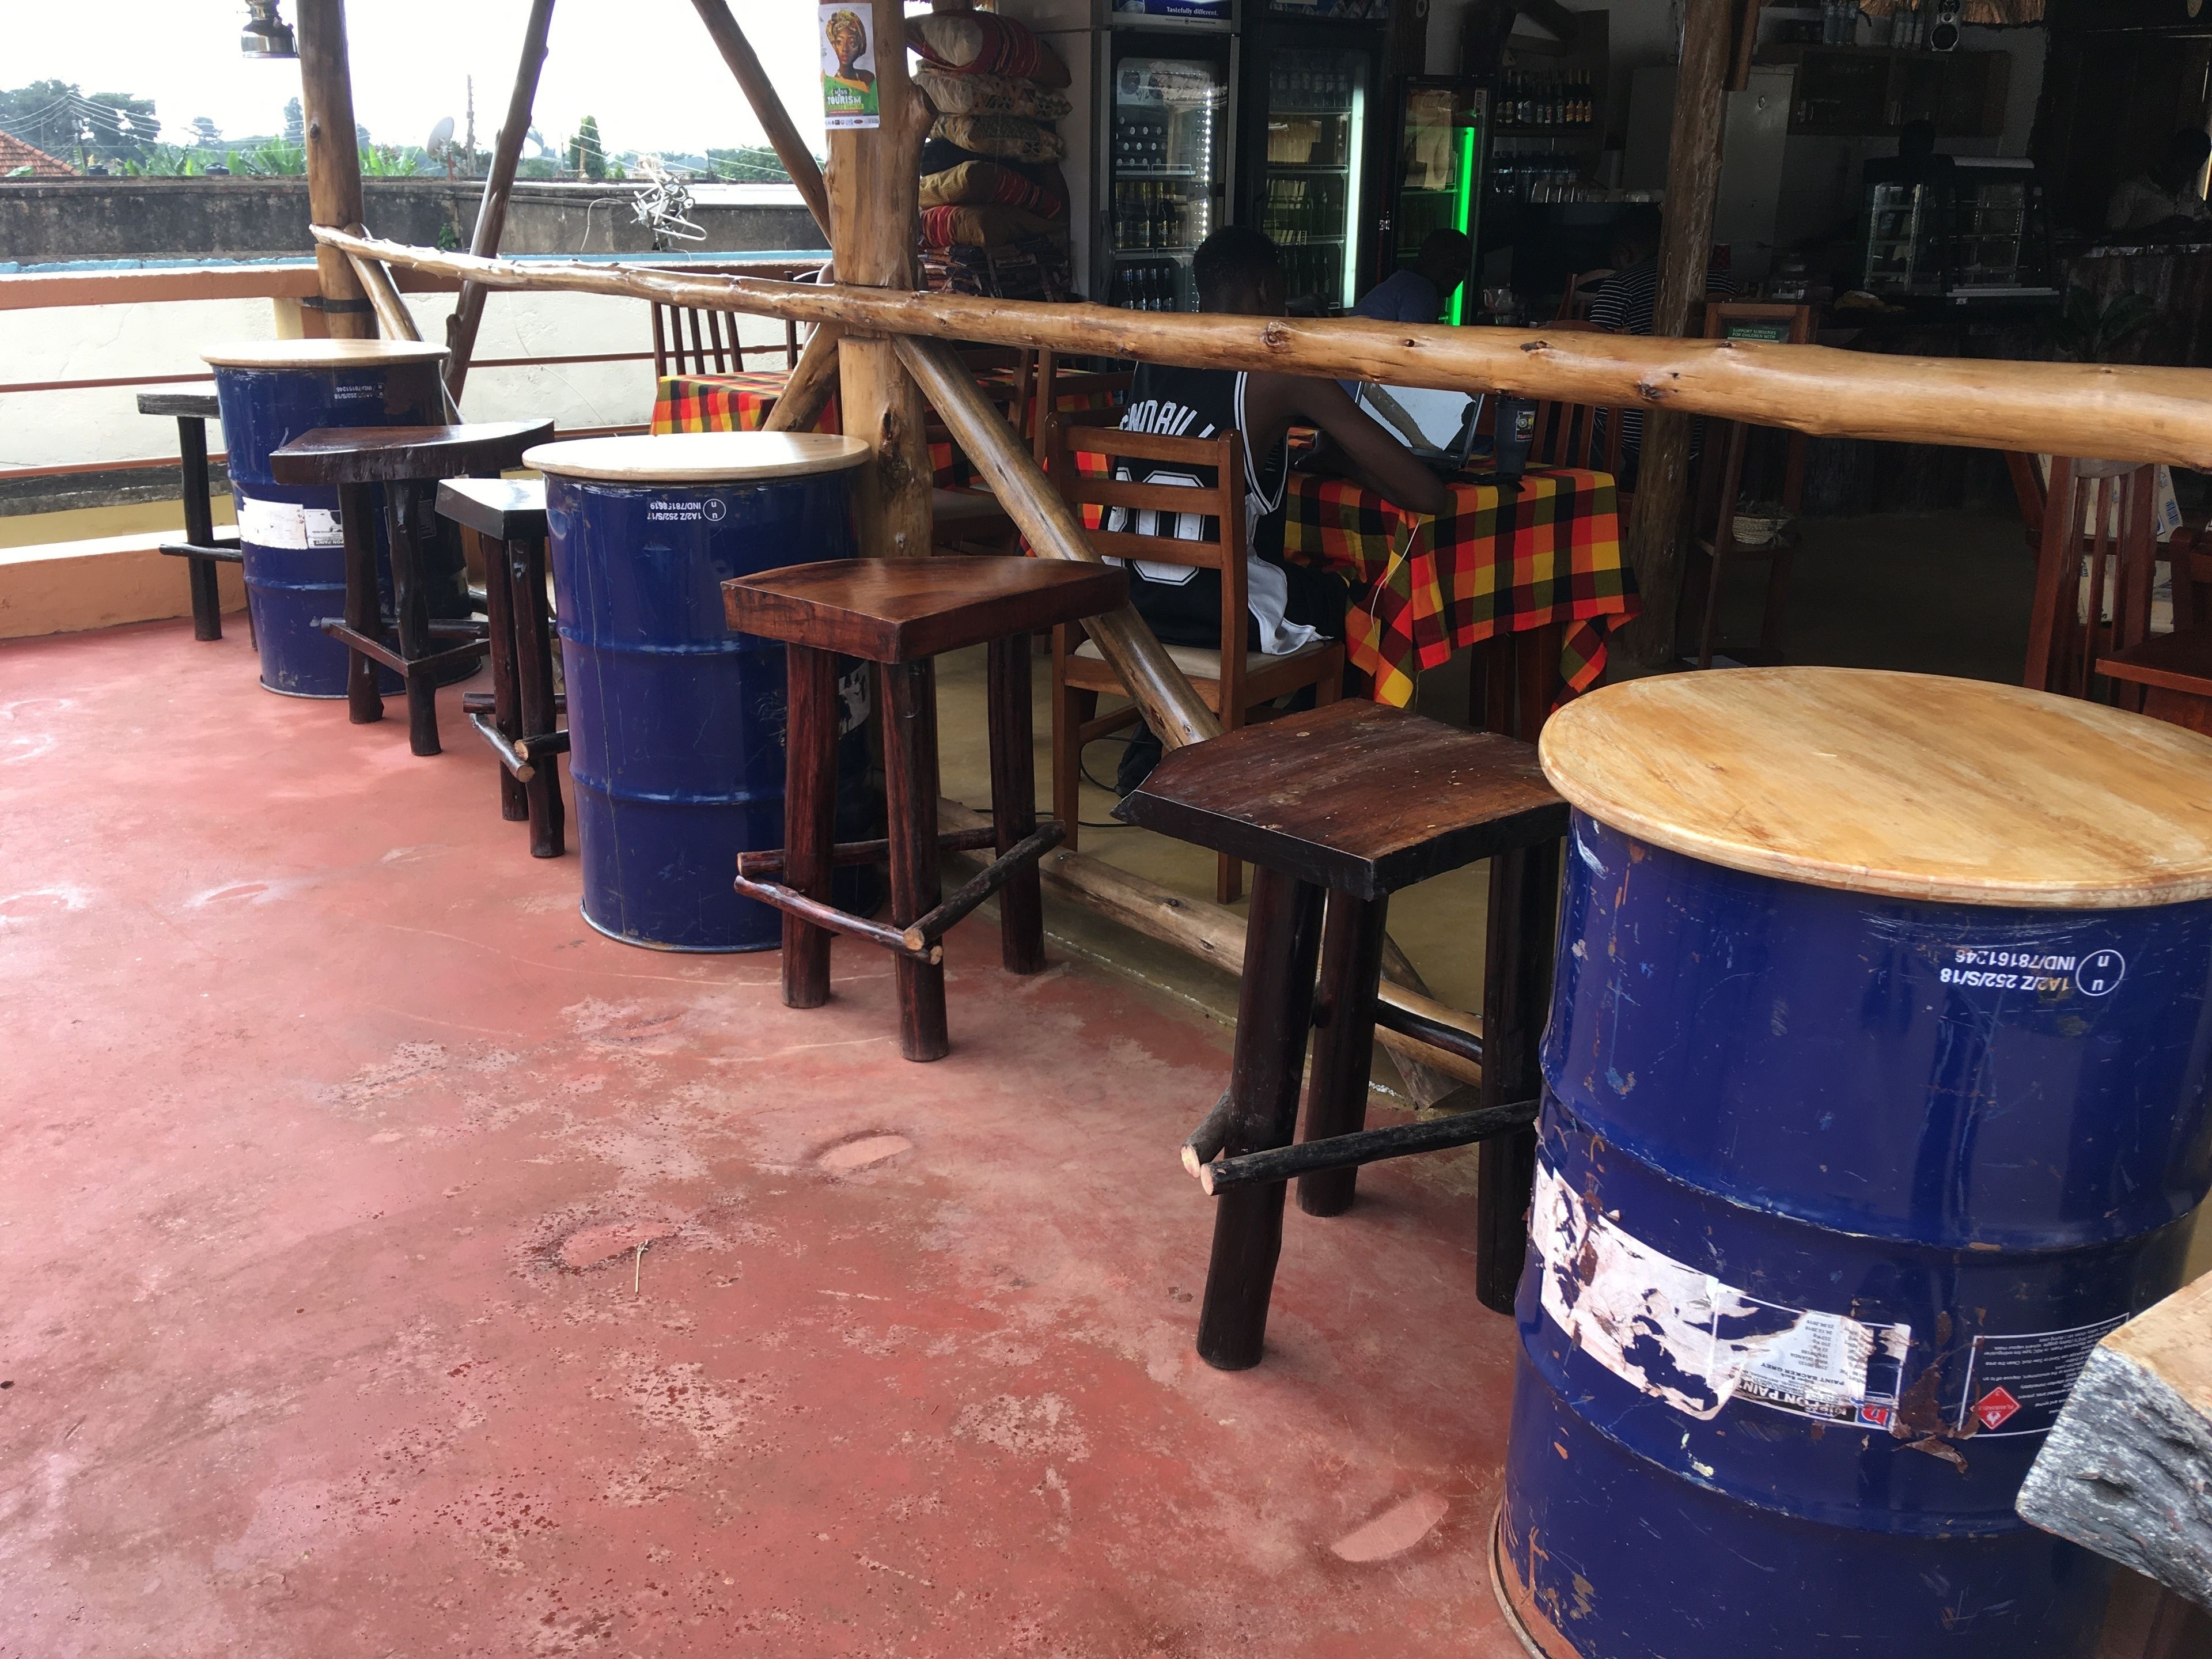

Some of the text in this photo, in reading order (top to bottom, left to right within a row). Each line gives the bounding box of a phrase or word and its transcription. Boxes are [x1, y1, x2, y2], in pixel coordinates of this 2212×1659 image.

[1166, 6, 1192, 15] Tastefully
[827, 96, 861, 104] TOURISM
[1941, 968, 2069, 991] 1A2/Z 252/S/18
[2092, 980, 2104, 991] u
[1760, 1362, 1782, 1372] GREY
[1785, 1369, 1817, 1380] BACKER
[1820, 1377, 1844, 1385] PAINT
